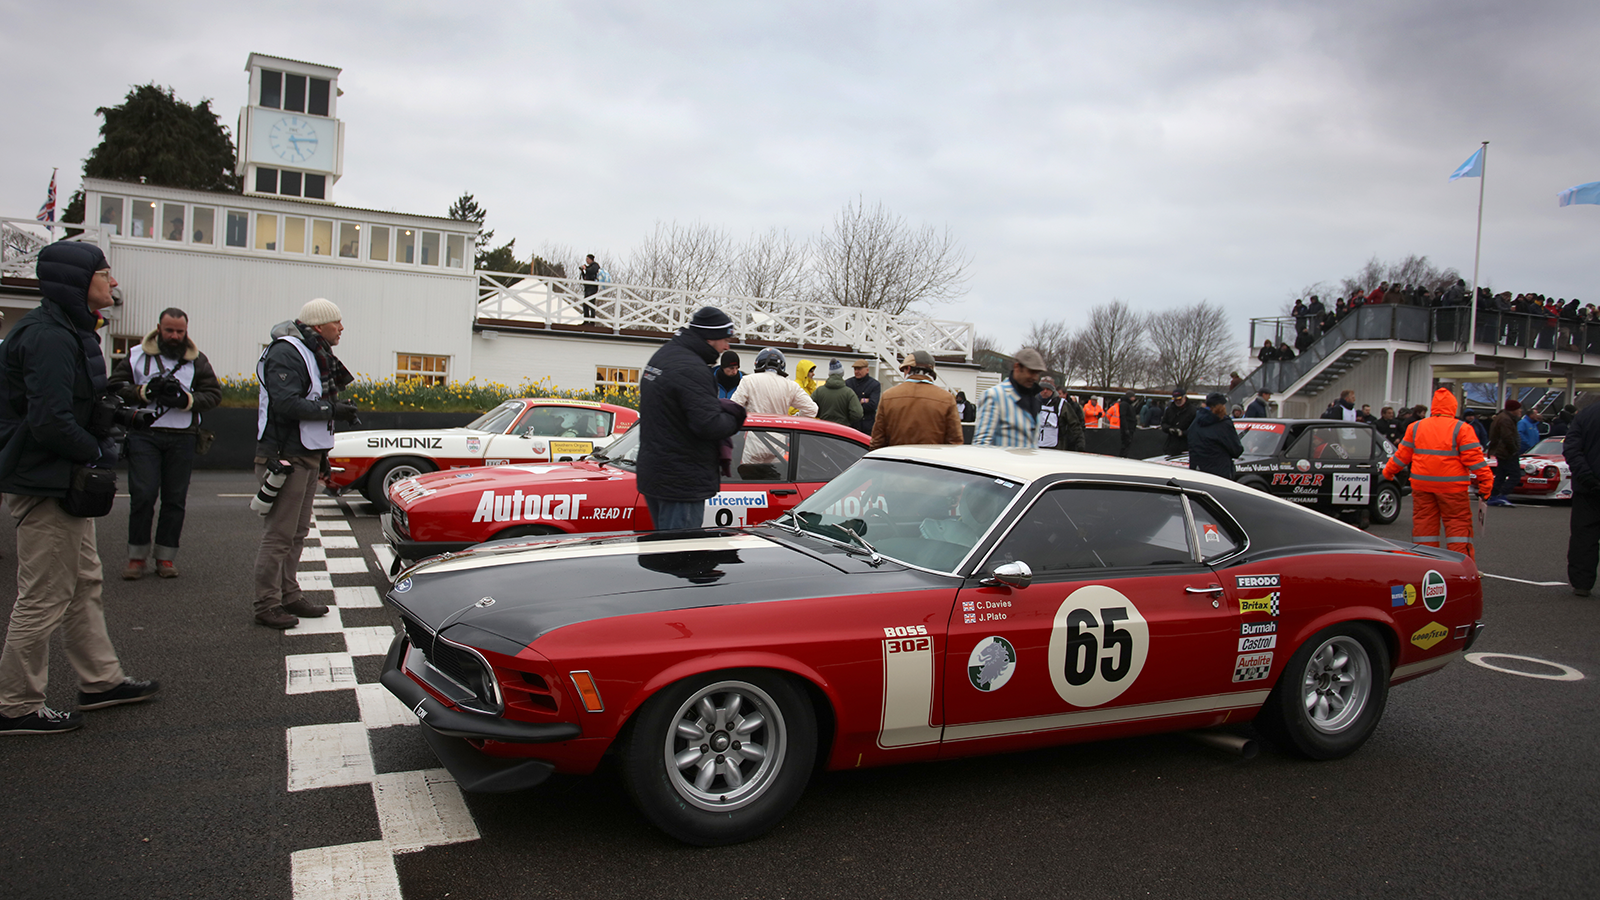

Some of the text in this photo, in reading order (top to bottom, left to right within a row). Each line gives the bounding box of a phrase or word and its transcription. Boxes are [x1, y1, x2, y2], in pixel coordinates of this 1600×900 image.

[367, 437, 443, 449] SIMONIZ
[1271, 473, 1325, 486] FLYER
[1292, 486, 1319, 494] Skates
[1338, 484, 1364, 502] 44
[472, 490, 587, 523] Autocar
[622, 507, 634, 519] IT
[1238, 577, 1279, 586] FERODO
[1426, 585, 1445, 597] Castrol
[986, 600, 1012, 609] Davies
[1241, 601, 1269, 610] Britax
[986, 612, 1007, 620] Plato
[883, 625, 928, 638] BOSS
[1242, 621, 1276, 635] Burmah
[887, 638, 930, 653] 302
[1064, 607, 1133, 687] 65
[1242, 636, 1273, 651] Castrol
[1237, 655, 1271, 668] Autolite
